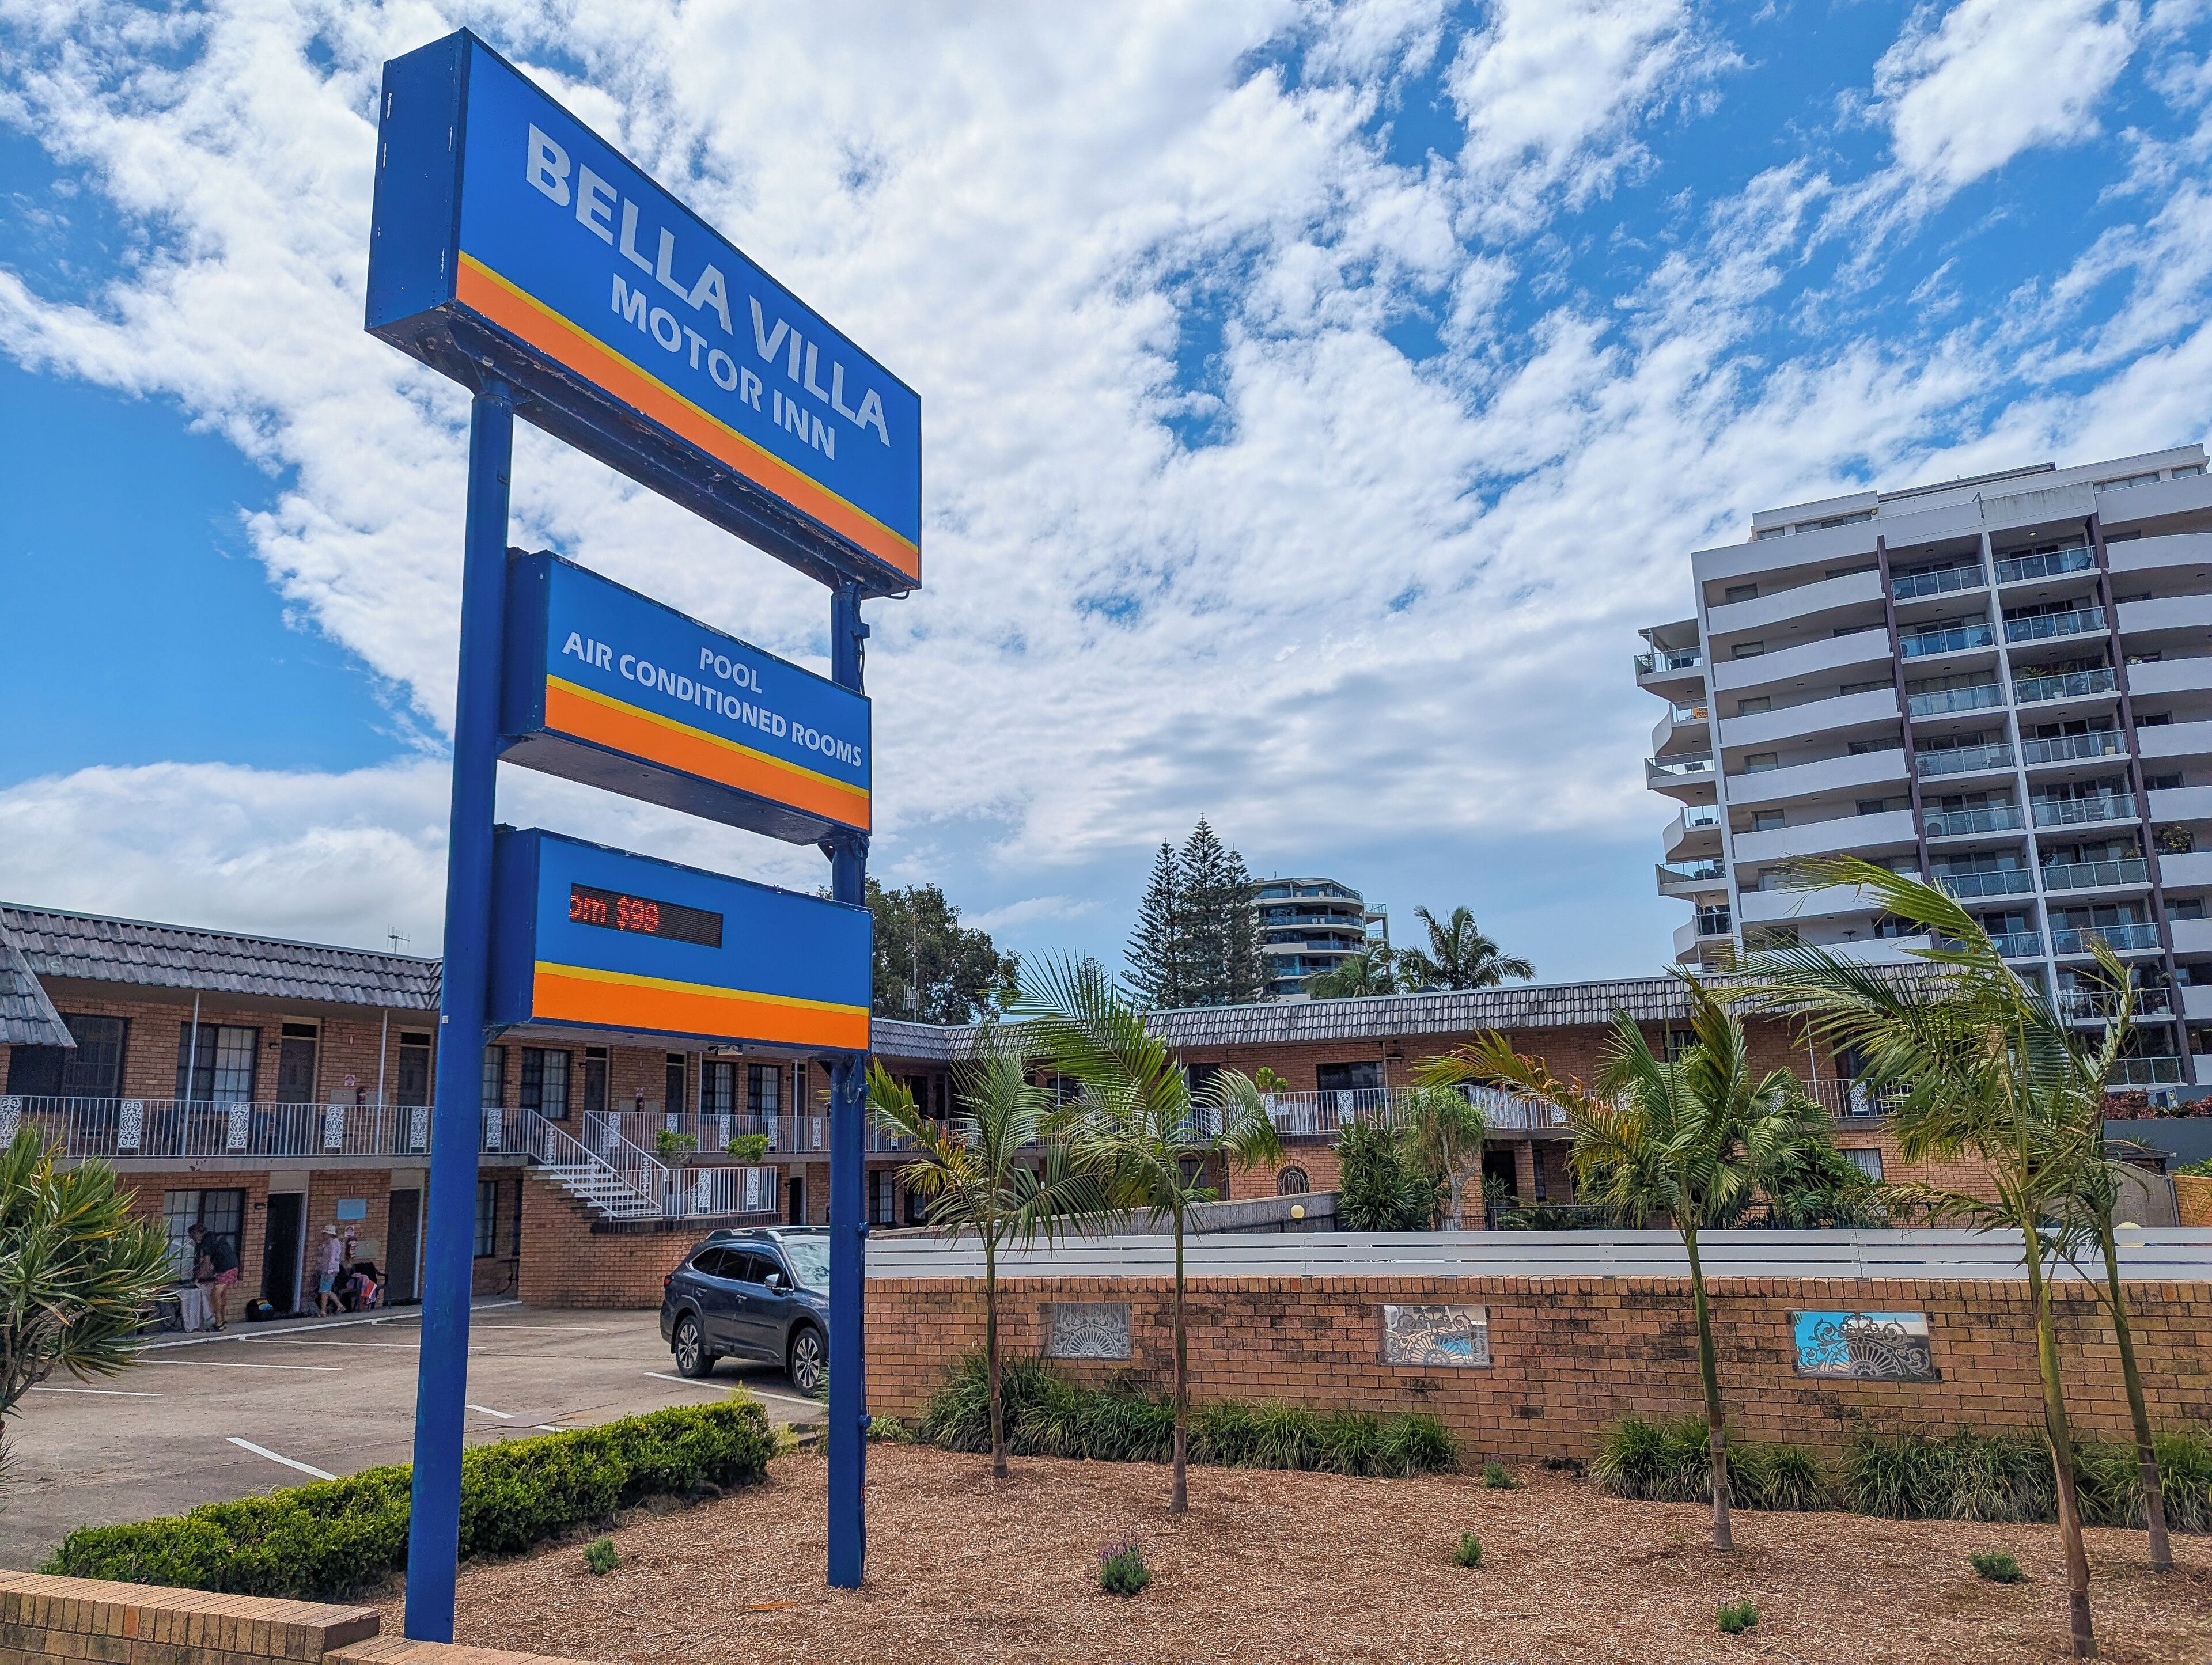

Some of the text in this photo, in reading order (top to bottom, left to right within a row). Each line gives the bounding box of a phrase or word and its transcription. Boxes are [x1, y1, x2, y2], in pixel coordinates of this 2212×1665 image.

[526, 122, 890, 447] BELLA VILLA
[611, 272, 835, 460] MOTOR INN
[562, 631, 862, 767] AIR CONDITIONED ROOMS
[700, 647, 762, 693] POOL
